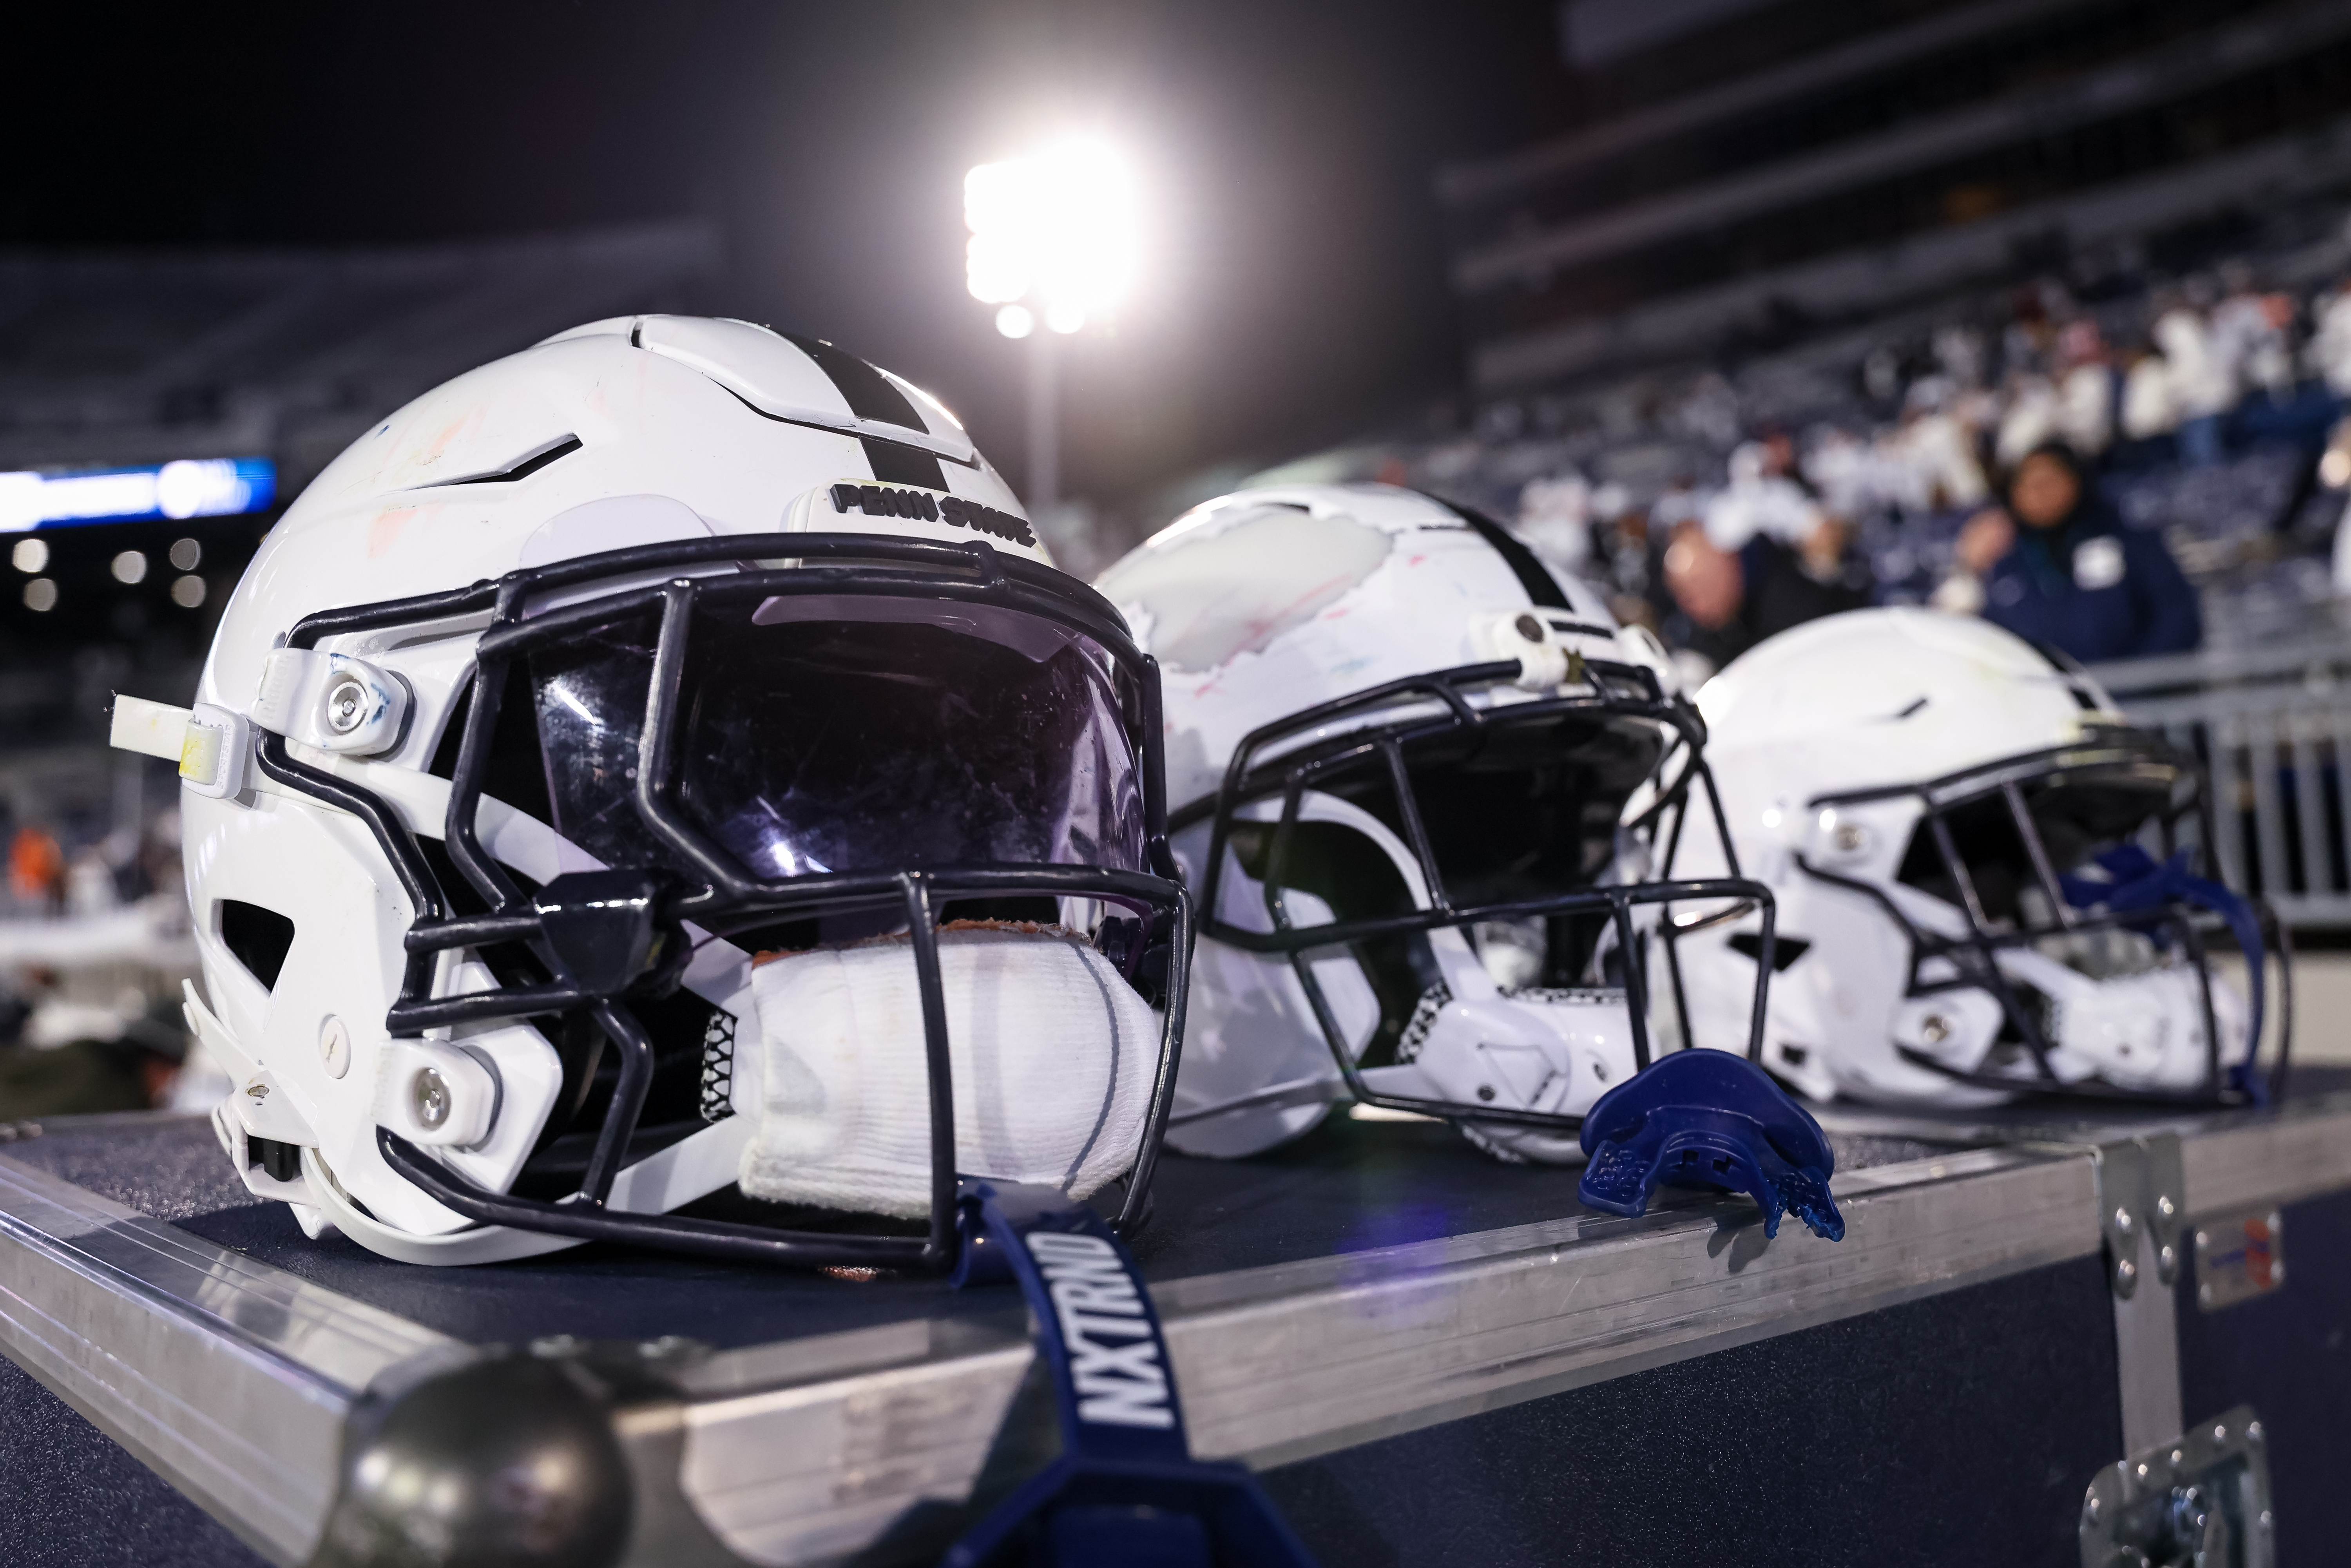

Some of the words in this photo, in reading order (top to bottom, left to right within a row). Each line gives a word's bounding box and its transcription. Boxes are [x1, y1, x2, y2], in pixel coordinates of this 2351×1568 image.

[830, 484, 939, 522] PENN
[938, 496, 1036, 548] STATE
[1025, 1232, 1174, 1427] NXTRND
